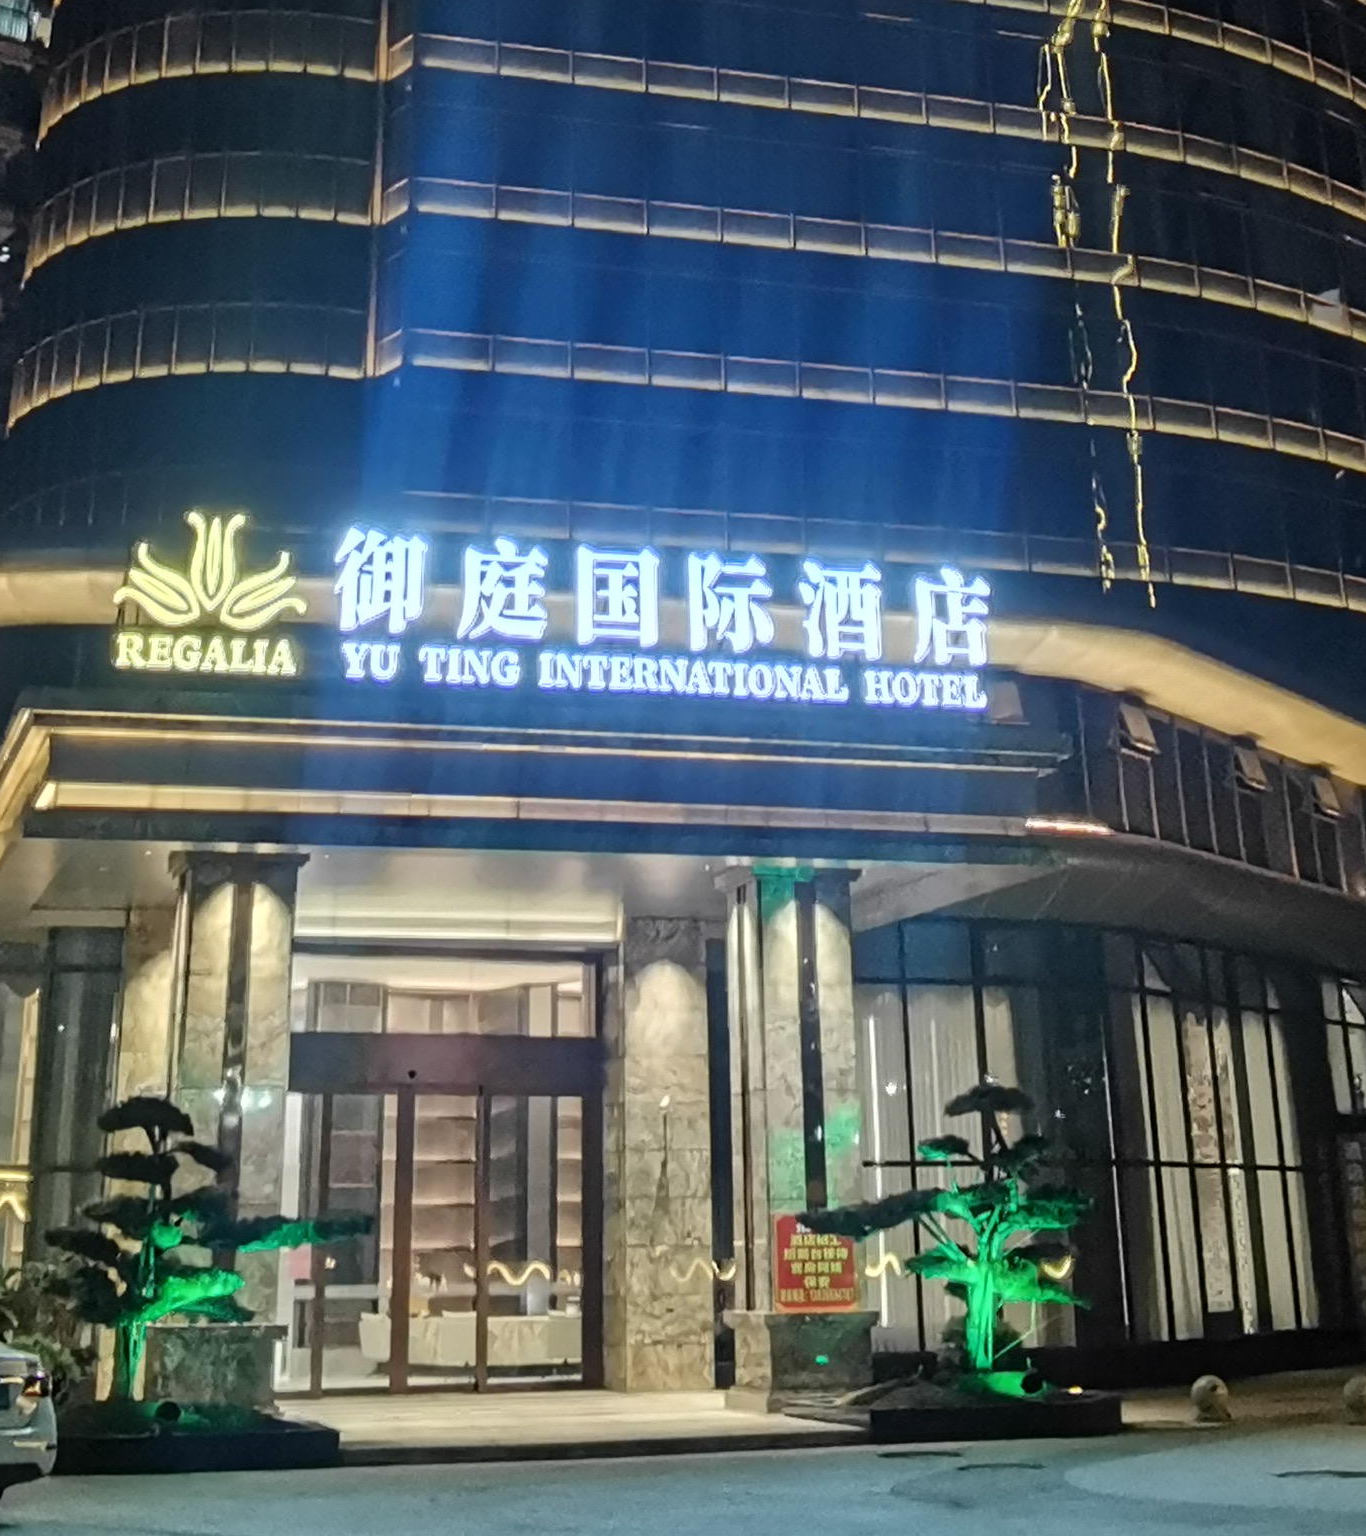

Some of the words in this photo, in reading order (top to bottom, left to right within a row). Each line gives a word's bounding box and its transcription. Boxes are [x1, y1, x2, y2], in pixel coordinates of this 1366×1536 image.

[333, 524, 992, 666] 御庭国际酒店
[113, 632, 297, 676] REGALIA
[341, 641, 402, 681] YU
[418, 644, 522, 689] TING
[538, 651, 848, 702] INTERNATIONAL
[864, 670, 988, 710] HOTEL
